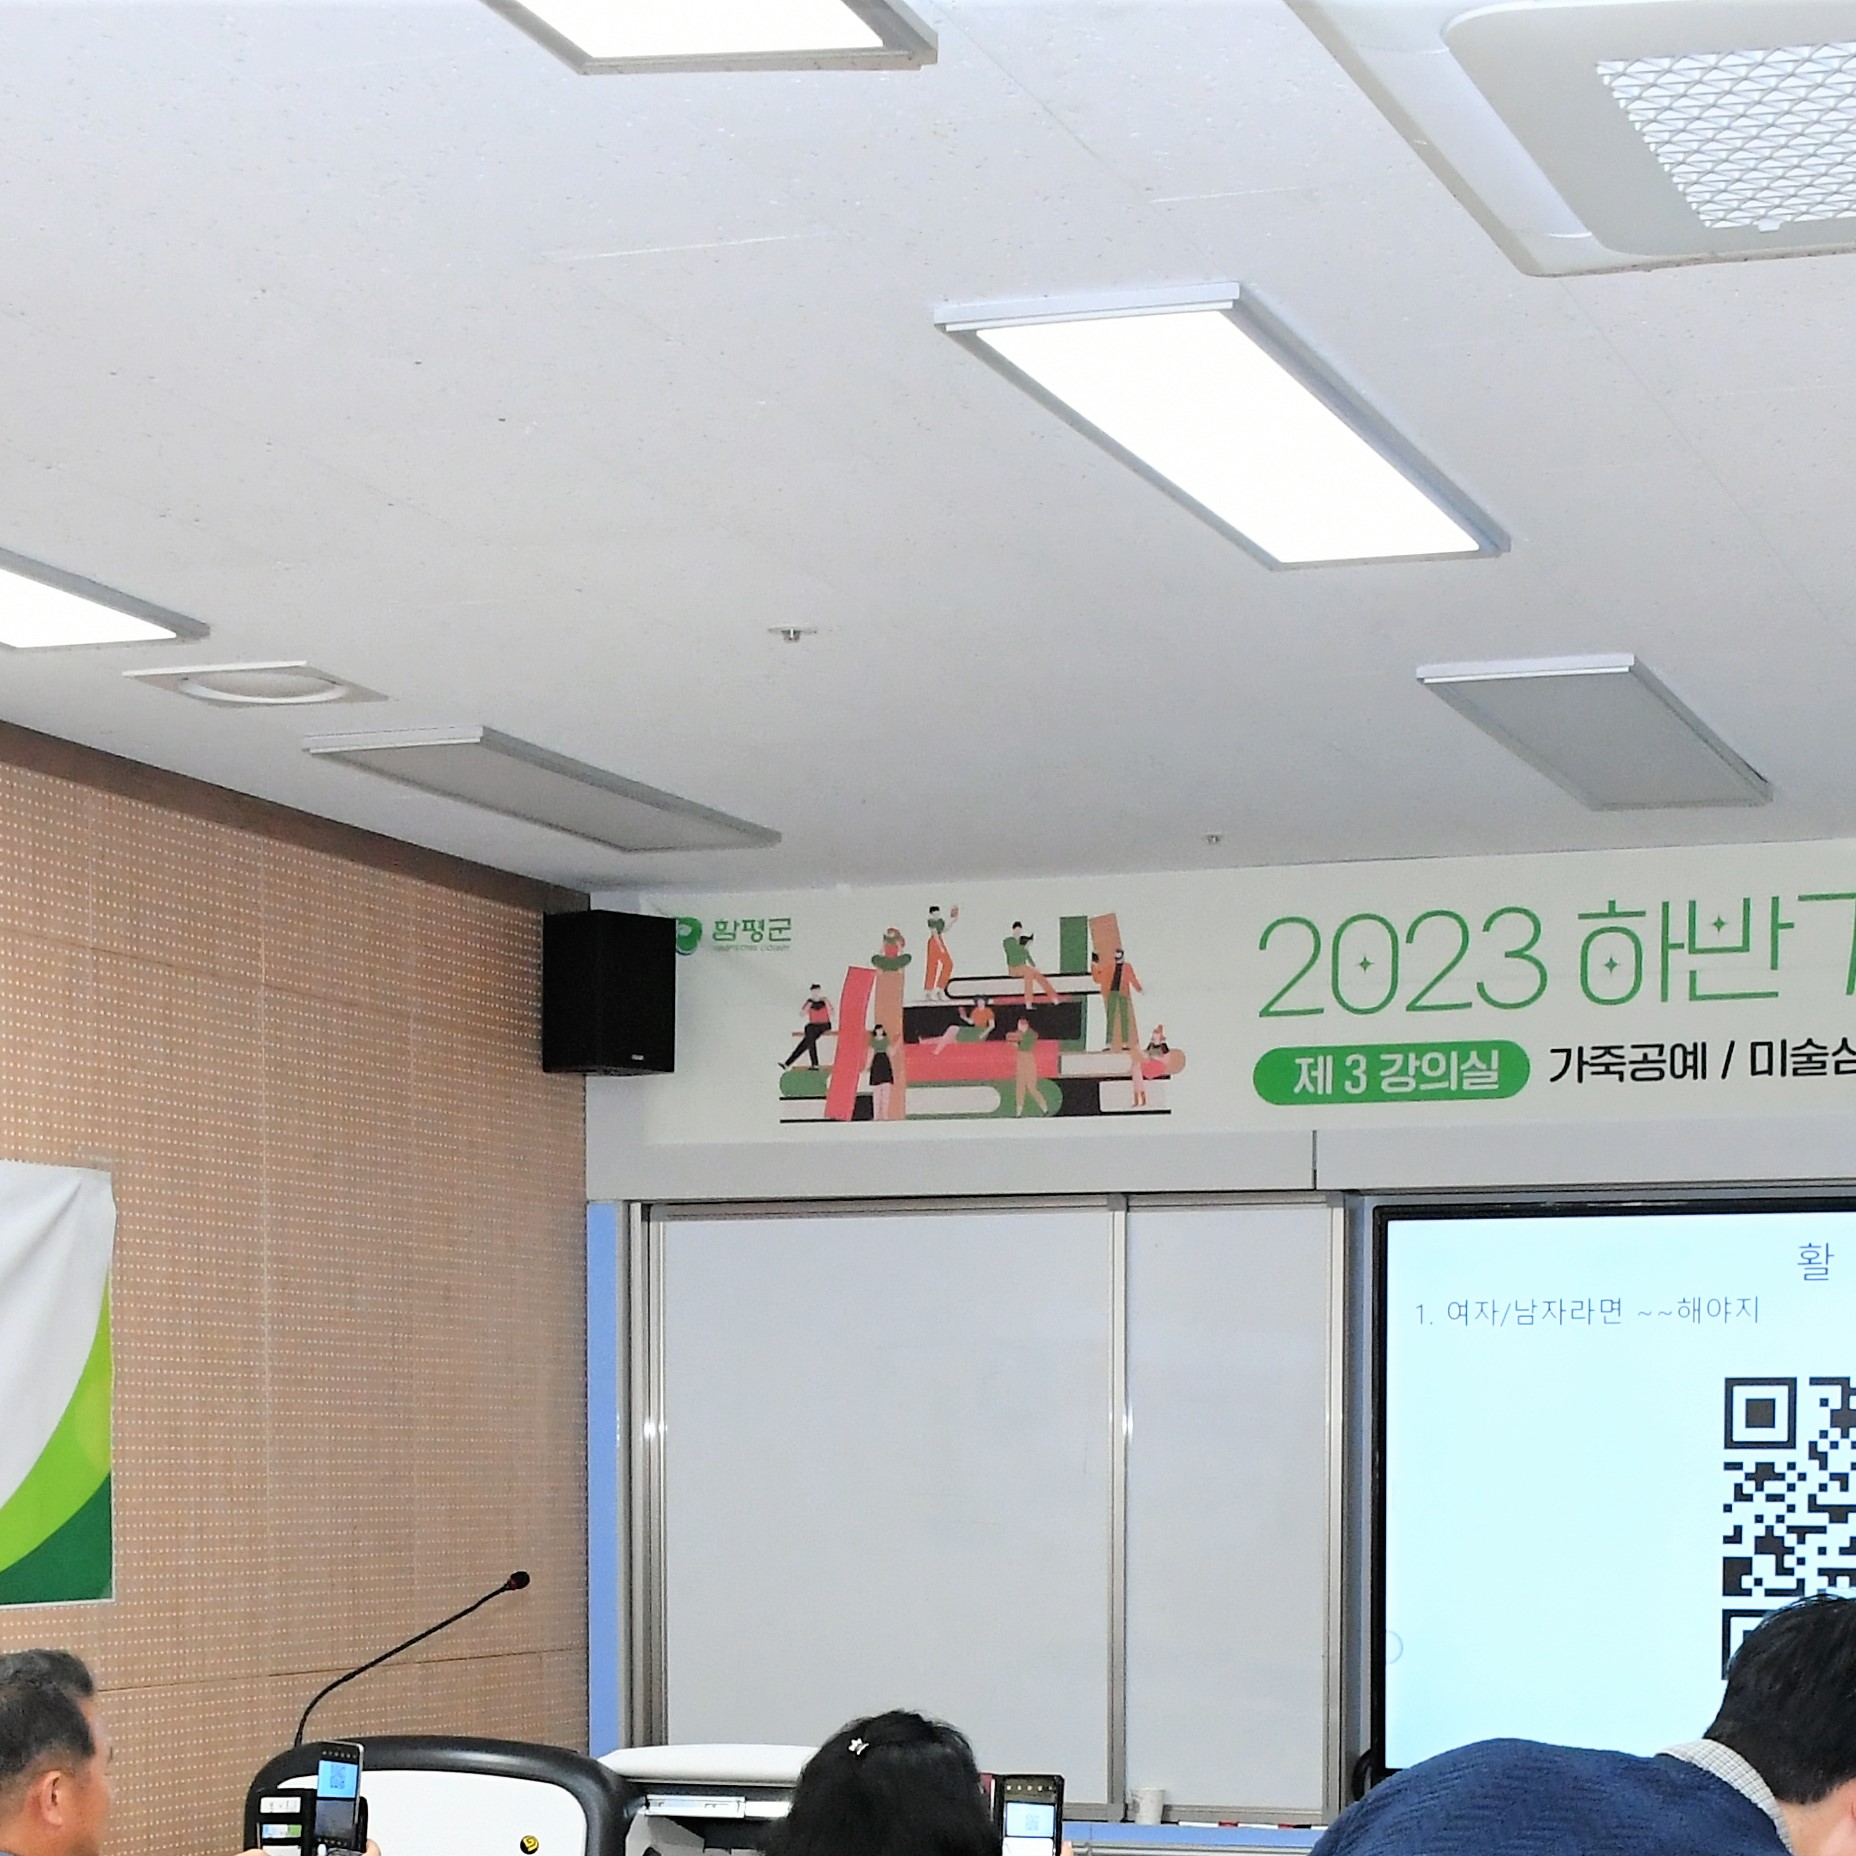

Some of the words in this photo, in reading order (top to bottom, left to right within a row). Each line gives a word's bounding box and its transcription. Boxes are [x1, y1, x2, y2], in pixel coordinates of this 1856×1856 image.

[711, 917, 792, 943] 함평군
[1259, 906, 1548, 1018] 2023
[1294, 1056, 1332, 1095] 제
[1345, 1054, 1367, 1094] 3
[1380, 1050, 1499, 1093] 강의실
[1549, 1042, 1707, 1084] 가죽공예
[1721, 1040, 1736, 1080] /
[1415, 1304, 1433, 1326] 1.
[1447, 1298, 1622, 1327] 여자/남자라면
